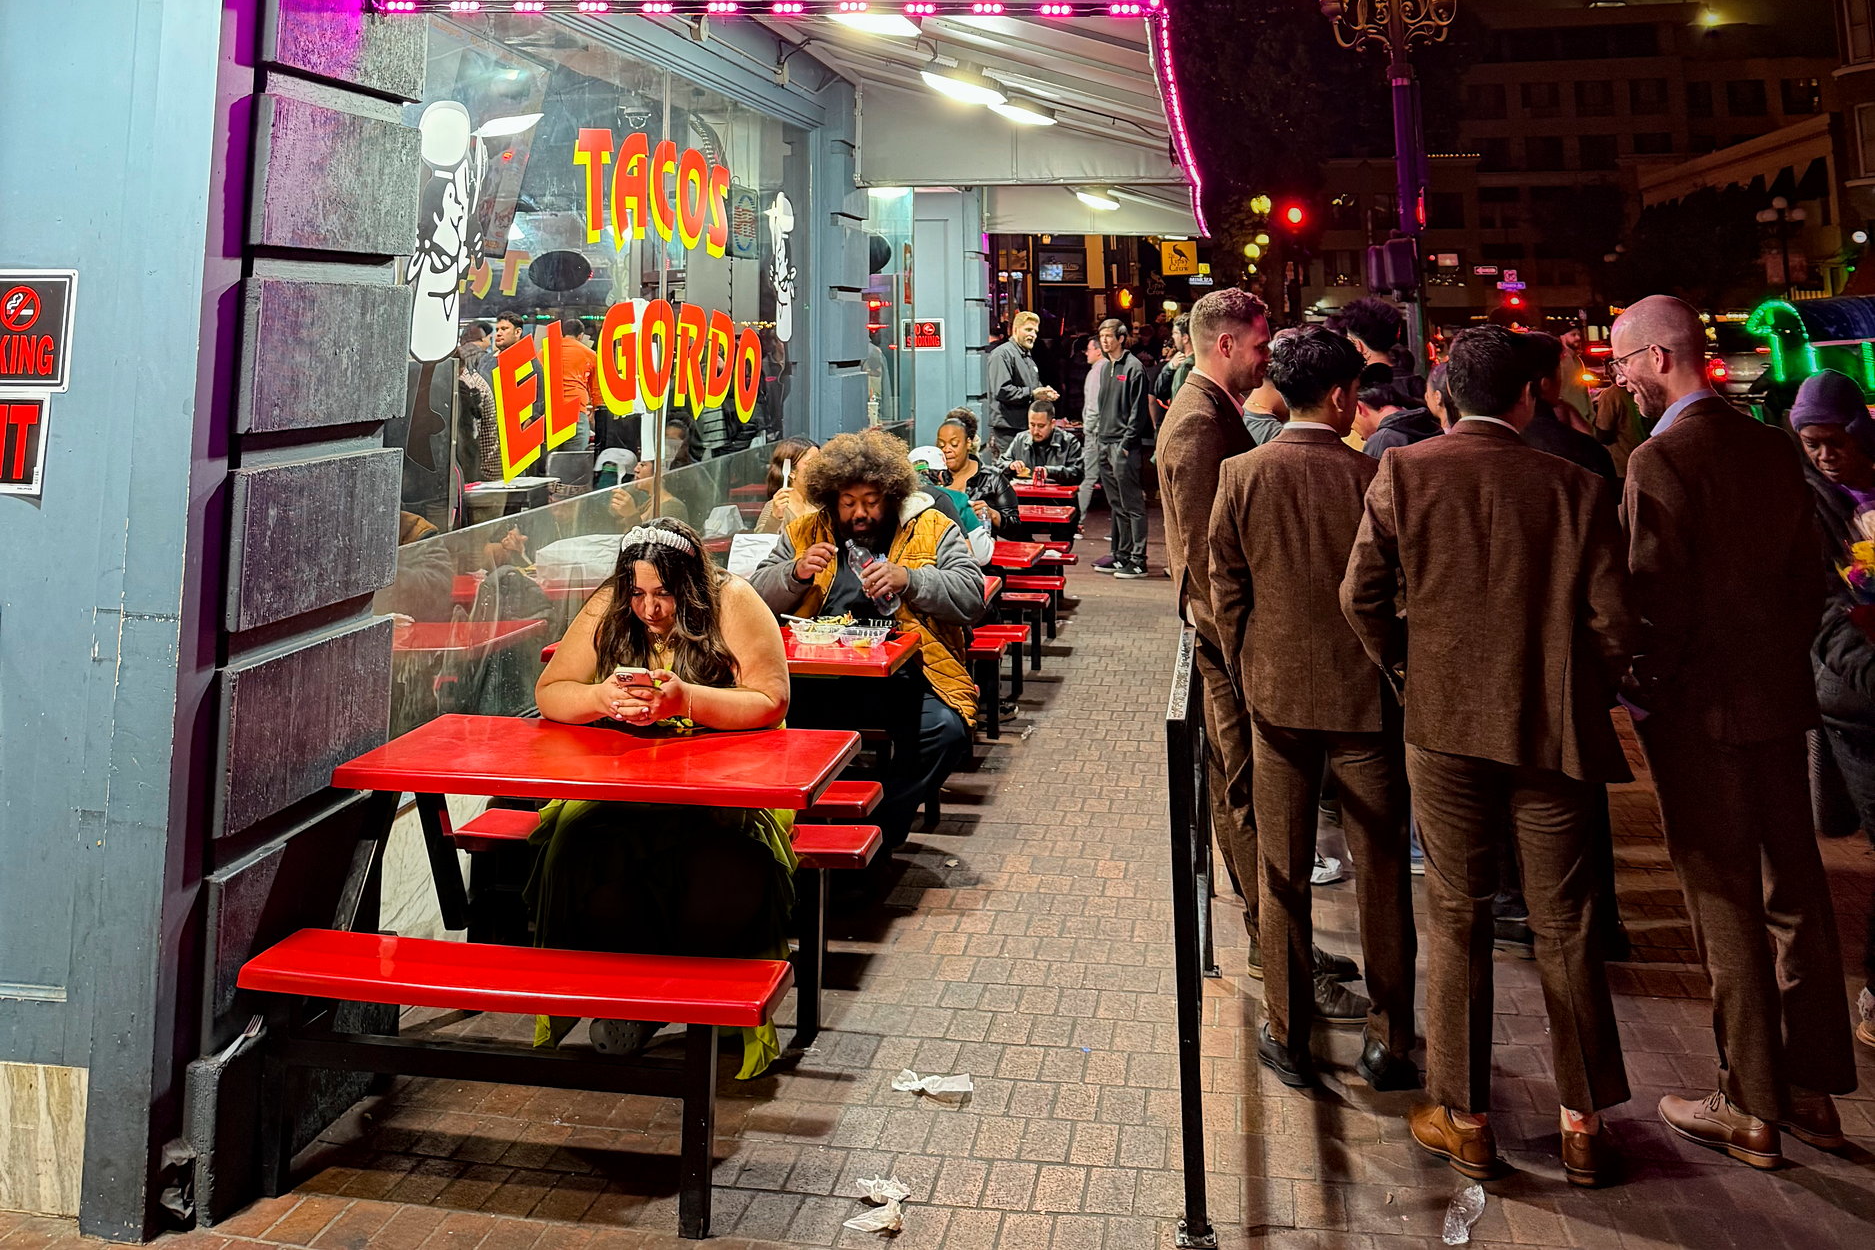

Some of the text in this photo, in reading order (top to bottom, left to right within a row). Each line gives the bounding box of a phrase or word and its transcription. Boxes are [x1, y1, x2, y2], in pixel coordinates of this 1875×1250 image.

[573, 127, 731, 260] TACOS
[0, 334, 55, 376] KING
[492, 297, 763, 485] EL GORDO
